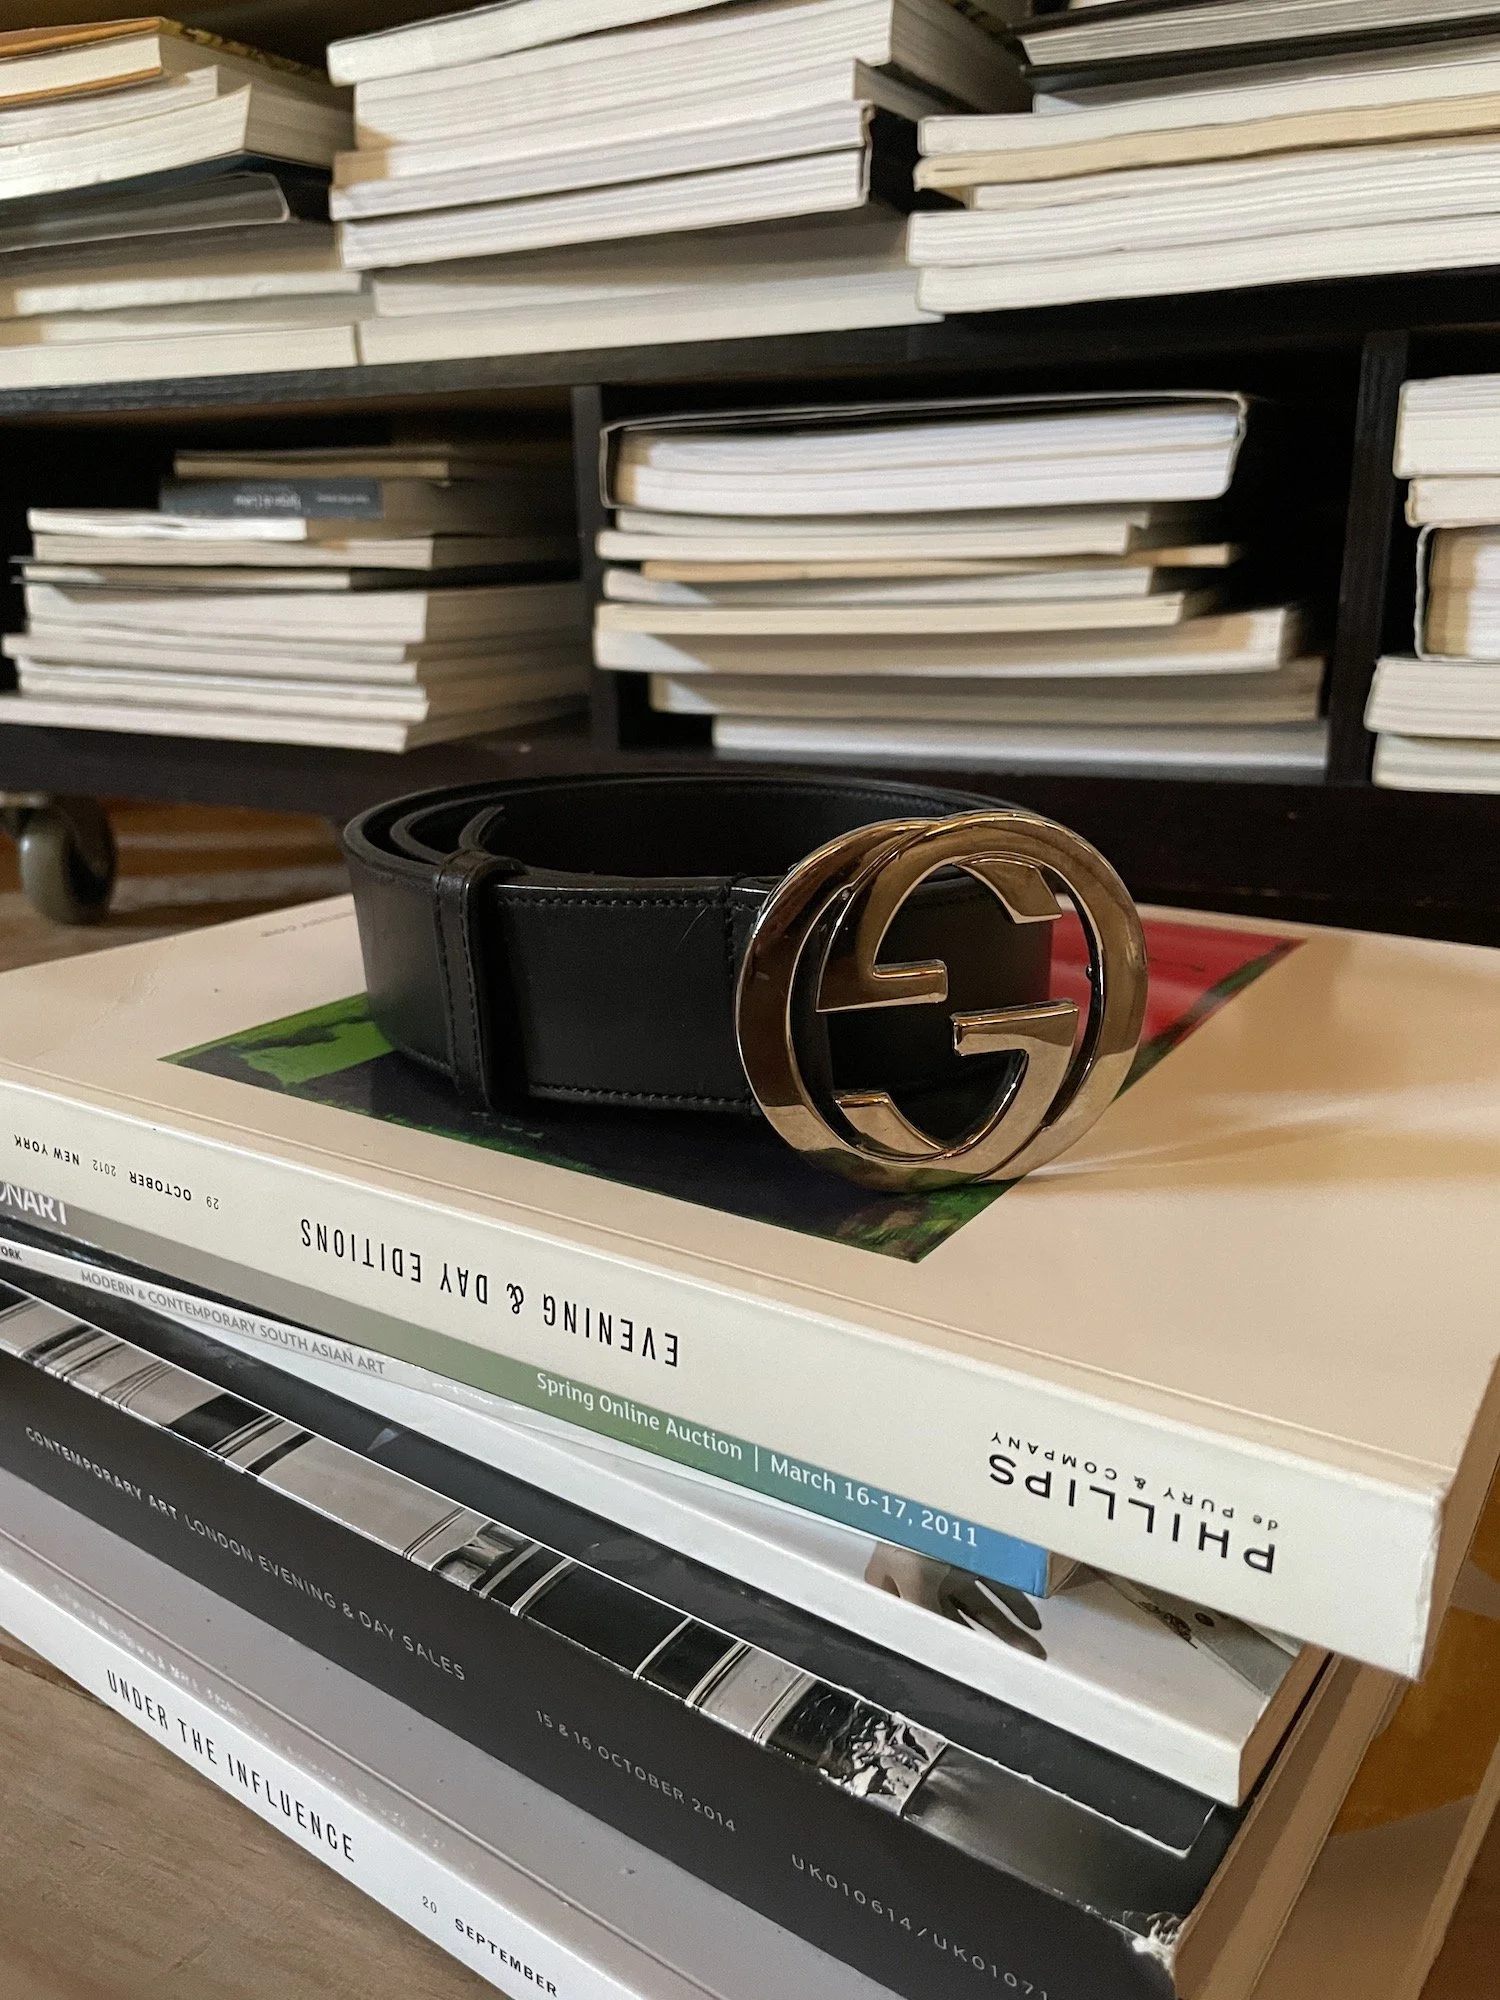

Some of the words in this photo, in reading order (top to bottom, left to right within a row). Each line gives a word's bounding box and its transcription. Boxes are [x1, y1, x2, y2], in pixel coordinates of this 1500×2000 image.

[14, 1135, 48, 1156] YORK
[53, 1147, 80, 1166] NEW
[92, 1160, 116, 1177] 2012
[130, 1171, 192, 1201] OCTOBER
[206, 1196, 219, 1210] 29
[300, 1219, 422, 1283] EDITIONS
[439, 1263, 489, 1305] DAY
[506, 1283, 525, 1314] &
[81, 1270, 135, 1297] MODERN
[138, 1289, 147, 1300] &
[148, 1290, 256, 1336] CONTEMPORARY
[260, 1325, 308, 1351] SOUTH
[312, 1341, 354, 1366] ASIAN
[357, 1356, 386, 1375] ART
[542, 1294, 679, 1368] EVENING
[537, 1372, 594, 1412] Spring
[599, 1394, 661, 1432] Online
[665, 1417, 743, 1461] Auction
[770, 1454, 836, 1495] March
[844, 1481, 914, 1527] 16-17,
[921, 1509, 979, 1548] 2011
[991, 1432, 1118, 1481] COMPANY
[1133, 1475, 1147, 1490] &
[1163, 1487, 1234, 1519] PURY
[988, 1454, 1276, 1574] PHILLIPS
[1252, 1514, 1278, 1531] de
[25, 1426, 142, 1501] CONTEMPORARY
[149, 1494, 178, 1520] ART
[184, 1513, 254, 1562] LONDON
[258, 1555, 337, 1609] EVENING
[342, 1602, 354, 1620] &
[359, 1610, 394, 1641] DAY
[402, 1635, 466, 1681] SALES
[107, 1669, 169, 1730] UNDER
[177, 1718, 218, 1765] THE
[227, 1753, 355, 1863] INFLUENCE
[536, 1710, 553, 1728] 15
[558, 1723, 569, 1737] &
[573, 1731, 592, 1751] 16
[597, 1745, 685, 1804] OCTOBER
[692, 1798, 736, 1832] 2014
[422, 1895, 438, 1915] 20
[454, 1918, 558, 1998] SEPTEMBER
